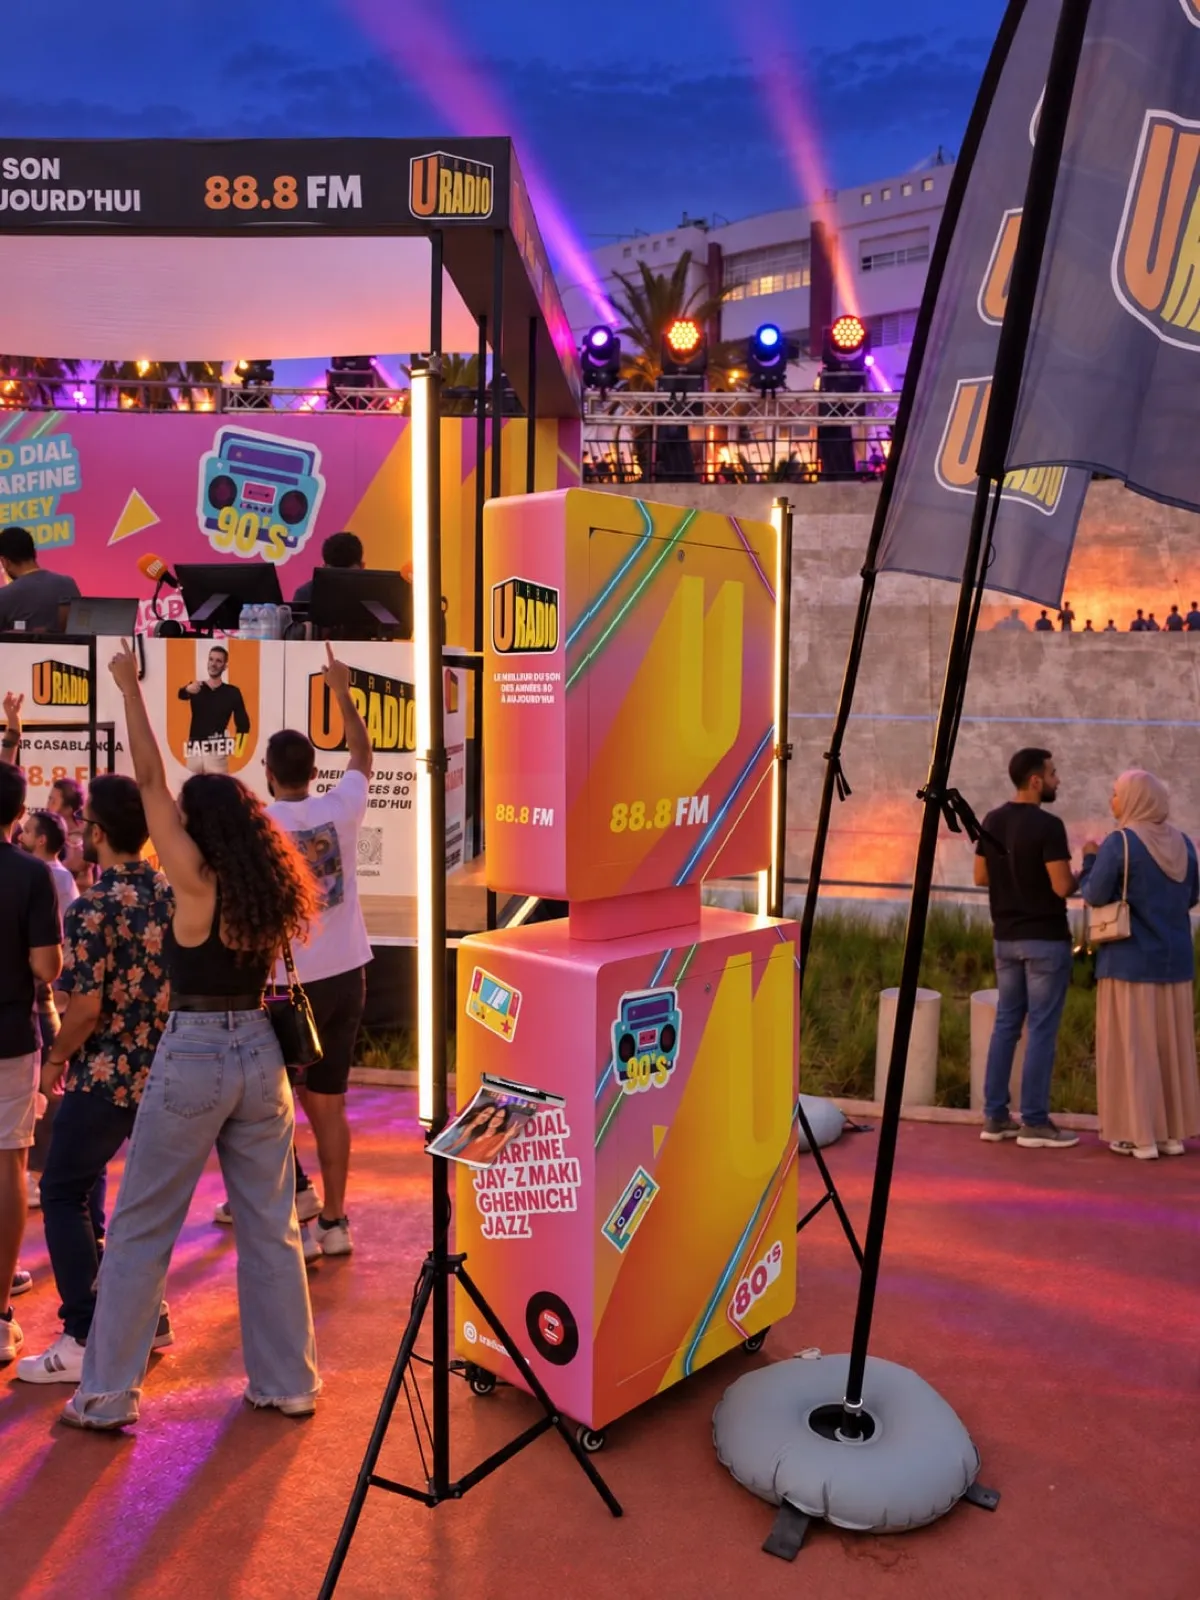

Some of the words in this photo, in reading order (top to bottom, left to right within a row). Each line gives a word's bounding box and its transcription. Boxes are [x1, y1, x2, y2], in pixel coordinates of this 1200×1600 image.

[2, 157, 60, 180] SON
[204, 175, 299, 210] 88.8
[306, 175, 363, 209] FM
[438, 167, 490, 214] RADIO
[20, 440, 73, 466] DIAL
[514, 596, 556, 649] RADIO
[51, 670, 89, 705] RADIO
[546, 673, 561, 682] SON
[392, 786, 410, 796] 80
[495, 804, 530, 824] 88.8
[532, 808, 554, 827] FM
[610, 798, 673, 833] 88.8
[675, 795, 709, 827] FM
[524, 1113, 568, 1138] DIAL
[492, 1139, 562, 1166] ARFINE
[475, 1166, 527, 1190] JAY-Z
[529, 1162, 578, 1187] MAKI
[479, 1188, 574, 1214] GHENNICH
[484, 1214, 530, 1236] JAZZ
